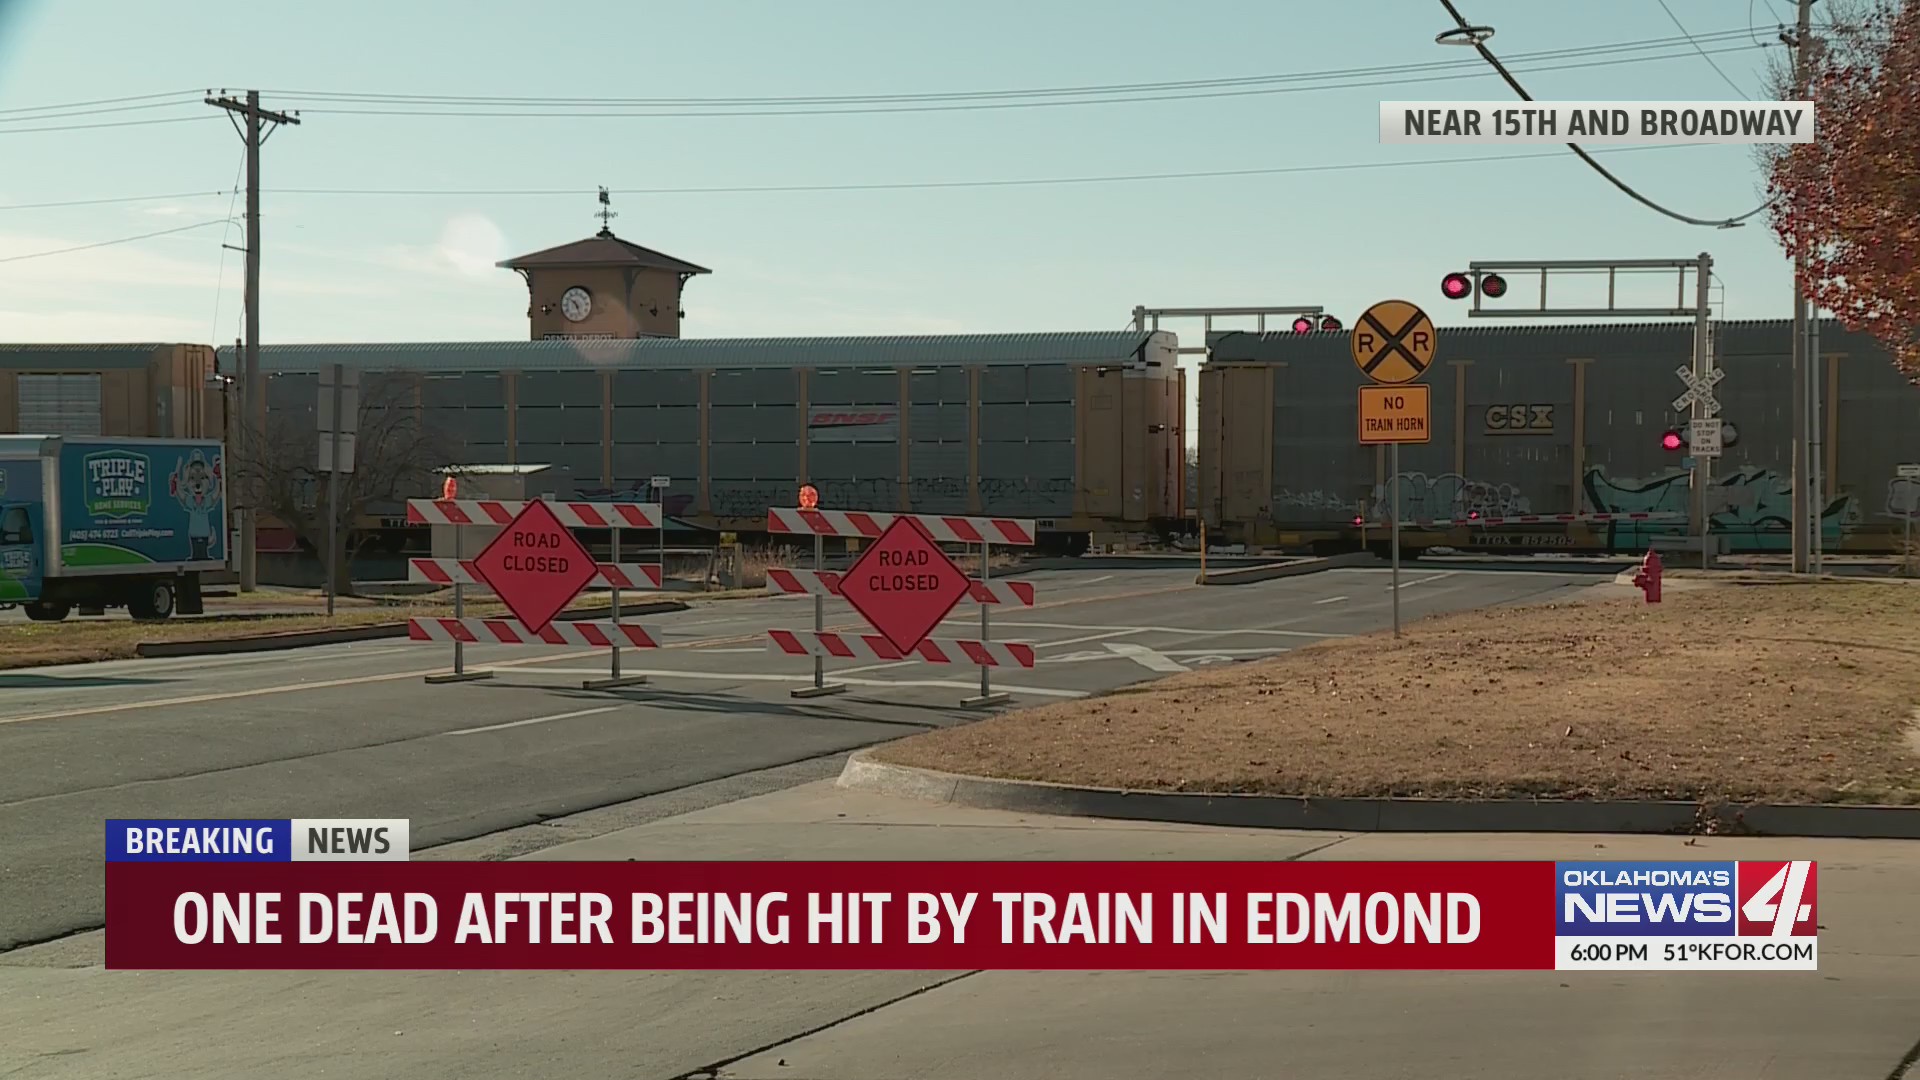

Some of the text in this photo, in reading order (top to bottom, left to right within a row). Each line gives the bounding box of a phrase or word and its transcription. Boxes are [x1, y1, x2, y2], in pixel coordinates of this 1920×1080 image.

[1358, 331, 1429, 353] R R
[1675, 369, 1723, 410] CROSSING
[1384, 396, 1404, 410] NO
[810, 412, 897, 425] BNSF
[1365, 417, 1424, 432] TRAIN HORN
[1485, 404, 1554, 429] CSX
[1692, 421, 1720, 429] DO NOT
[1696, 429, 1716, 437] STOP
[88, 458, 146, 483] TRIPLE
[101, 478, 134, 497] PLAY
[513, 531, 561, 549] ROAD
[1474, 535, 1512, 545] TTGX
[503, 555, 569, 574] CLOSED
[879, 550, 929, 567] ROAD
[869, 574, 939, 592] CLOSED
